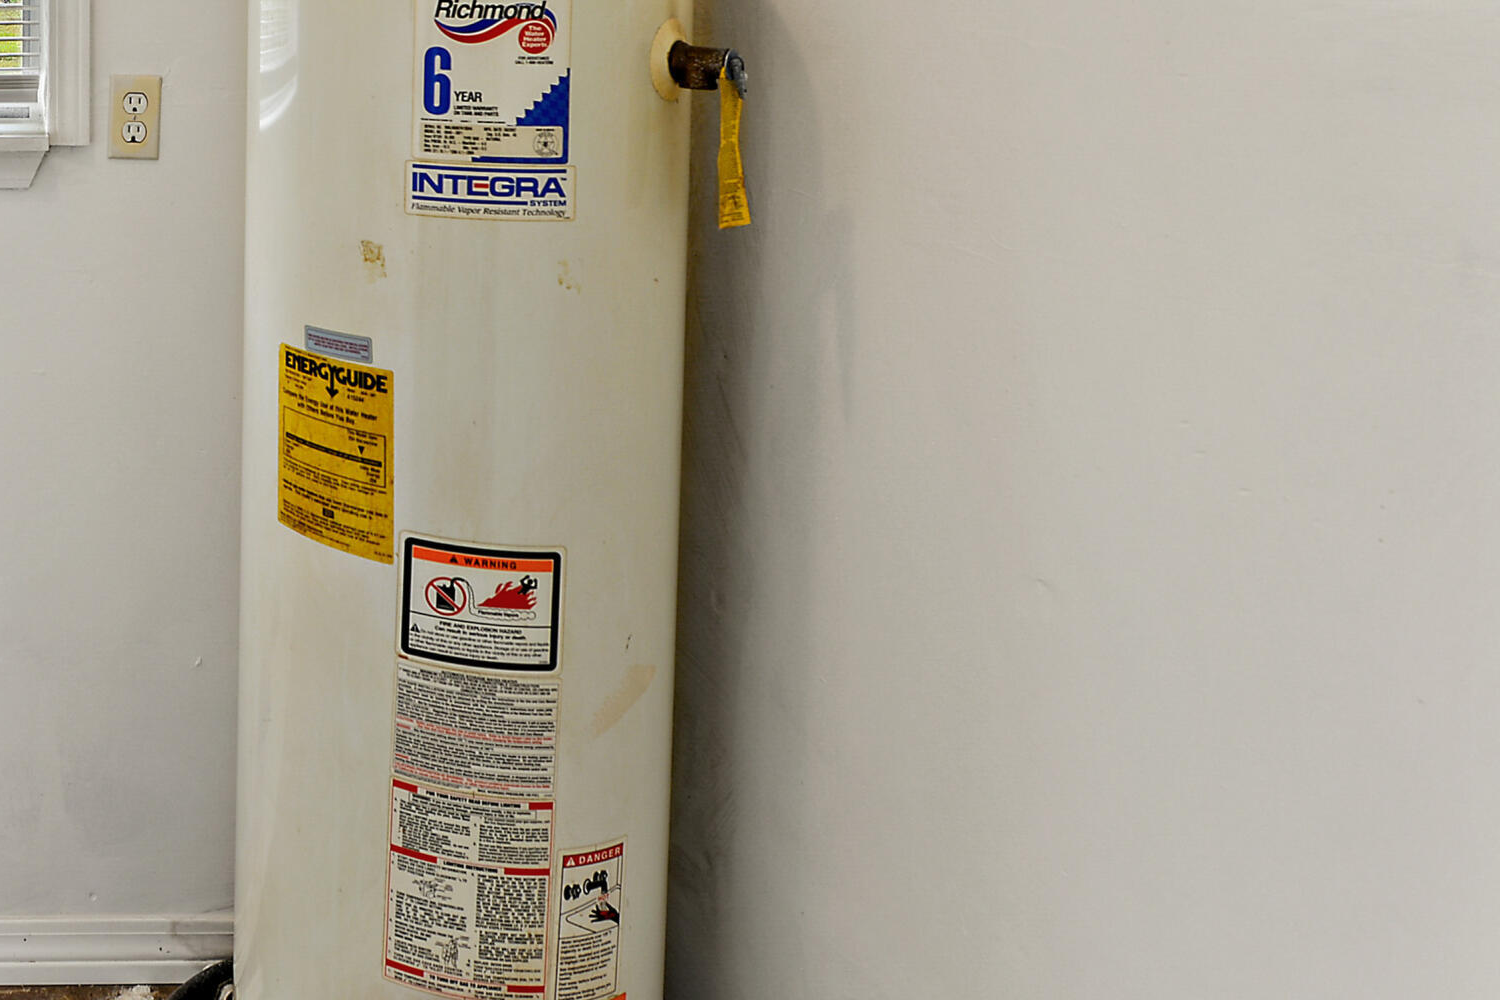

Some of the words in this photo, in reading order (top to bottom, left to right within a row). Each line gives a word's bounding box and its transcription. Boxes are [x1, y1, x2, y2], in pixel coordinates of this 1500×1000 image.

[435, 0, 547, 19] Richmond
[424, 46, 452, 115] 6
[453, 91, 482, 102] YEAR
[412, 172, 566, 198] INTEGRA
[411, 203, 455, 213] Flammable
[457, 206, 481, 216] Vapor
[483, 208, 520, 216] Resistant
[522, 209, 565, 219] Technology
[464, 557, 517, 569] WARNING
[579, 847, 621, 864] DANGER
